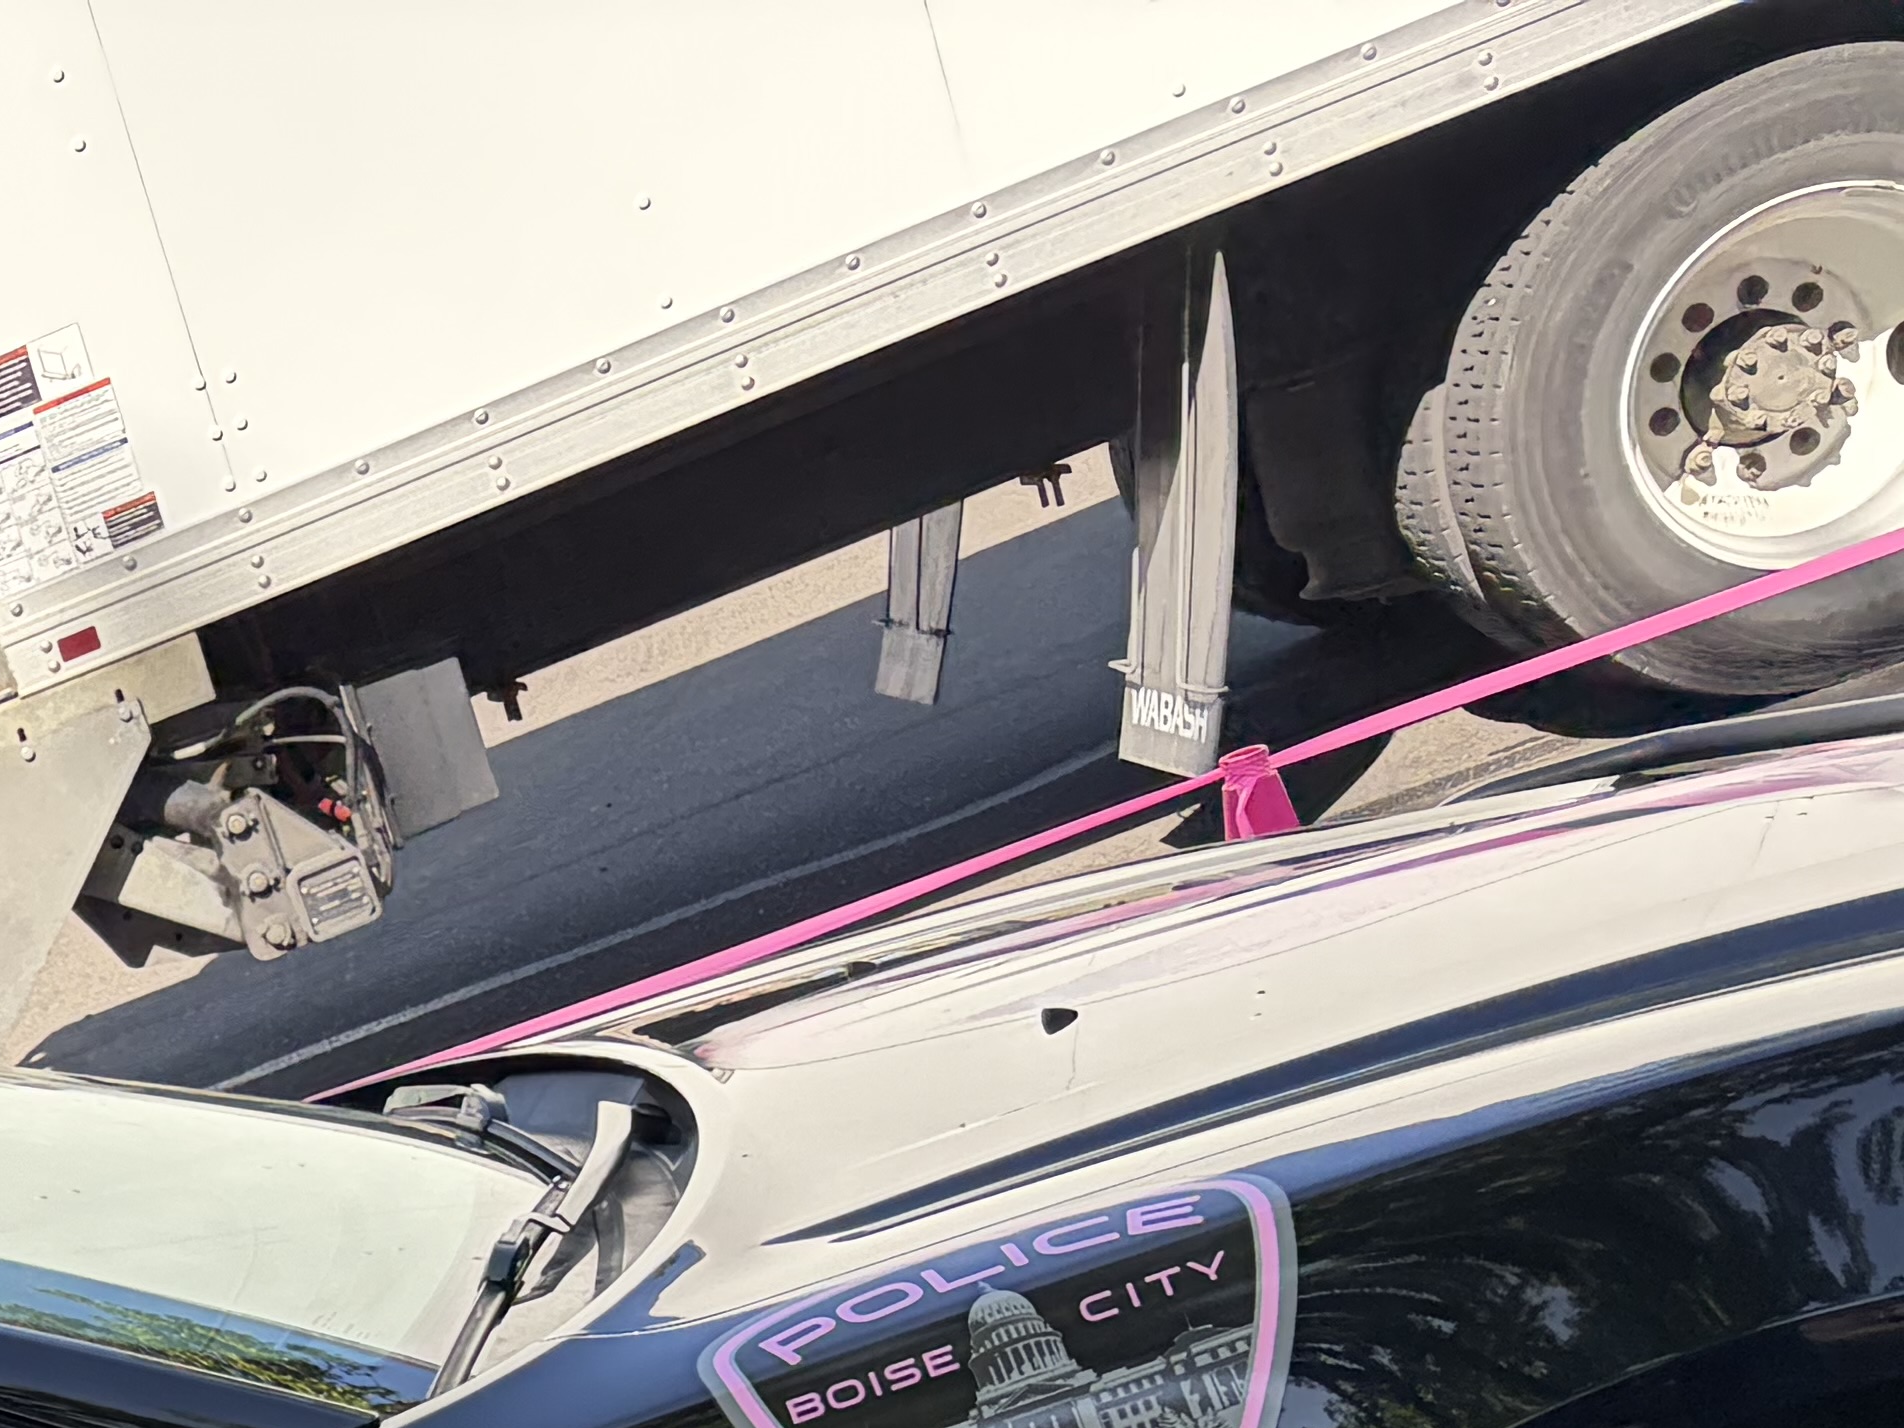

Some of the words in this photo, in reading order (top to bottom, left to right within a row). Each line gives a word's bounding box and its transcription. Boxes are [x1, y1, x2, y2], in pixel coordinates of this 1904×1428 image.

[1130, 686, 1209, 743] WABASH
[758, 1194, 1205, 1367] POLICE
[785, 1344, 961, 1425] BOISE
[1079, 1249, 1225, 1323] CITY
